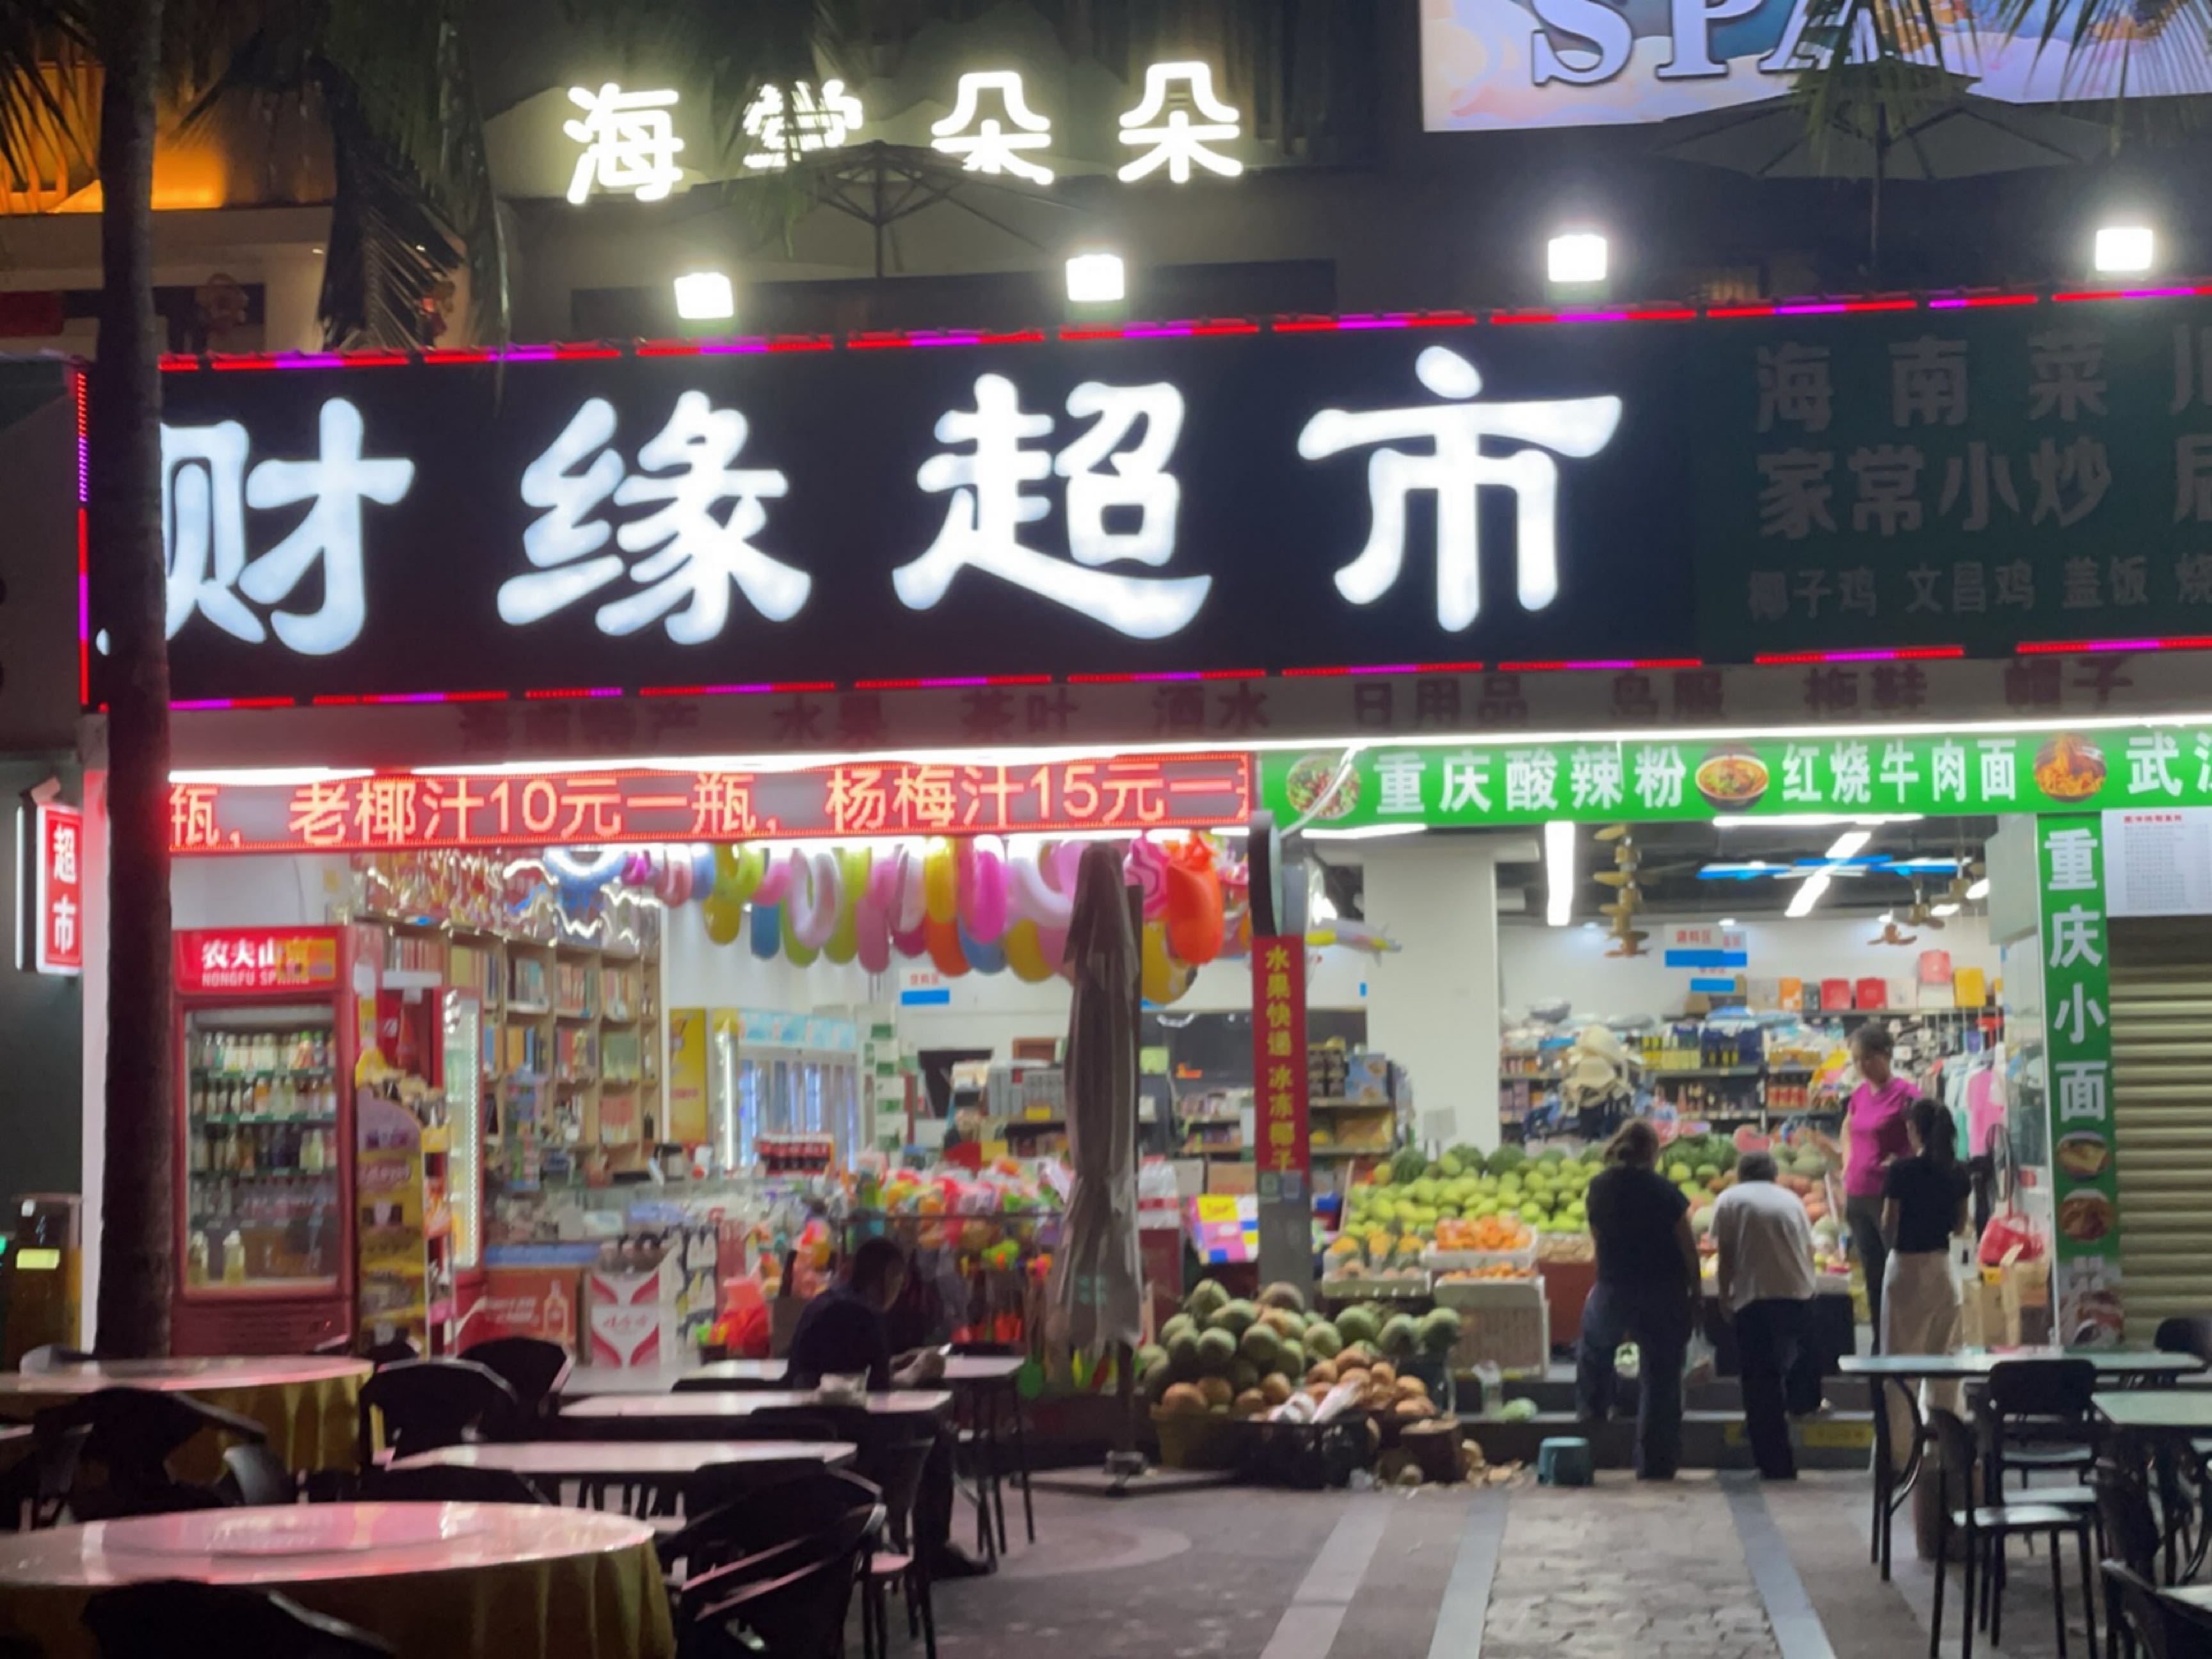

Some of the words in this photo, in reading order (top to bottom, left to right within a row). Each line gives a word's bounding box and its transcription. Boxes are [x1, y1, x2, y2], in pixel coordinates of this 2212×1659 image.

[1753, 328, 2108, 433] 海南菜
[160, 346, 1623, 655] 财缘超市
[1757, 435, 2112, 540] 家常小炒
[1905, 557, 2035, 614] 文昌鸡
[2062, 554, 2149, 609] 盖饭
[961, 687, 1079, 737] 茶叶
[1354, 674, 1528, 727] 日用品
[1373, 745, 1687, 815] 重庆酸辣粉
[1781, 737, 2017, 804] 红烧牛肉面
[52, 823, 77, 955] 超市
[202, 937, 315, 969] 农夫山
[2044, 828, 2108, 1122] 重庆小面
